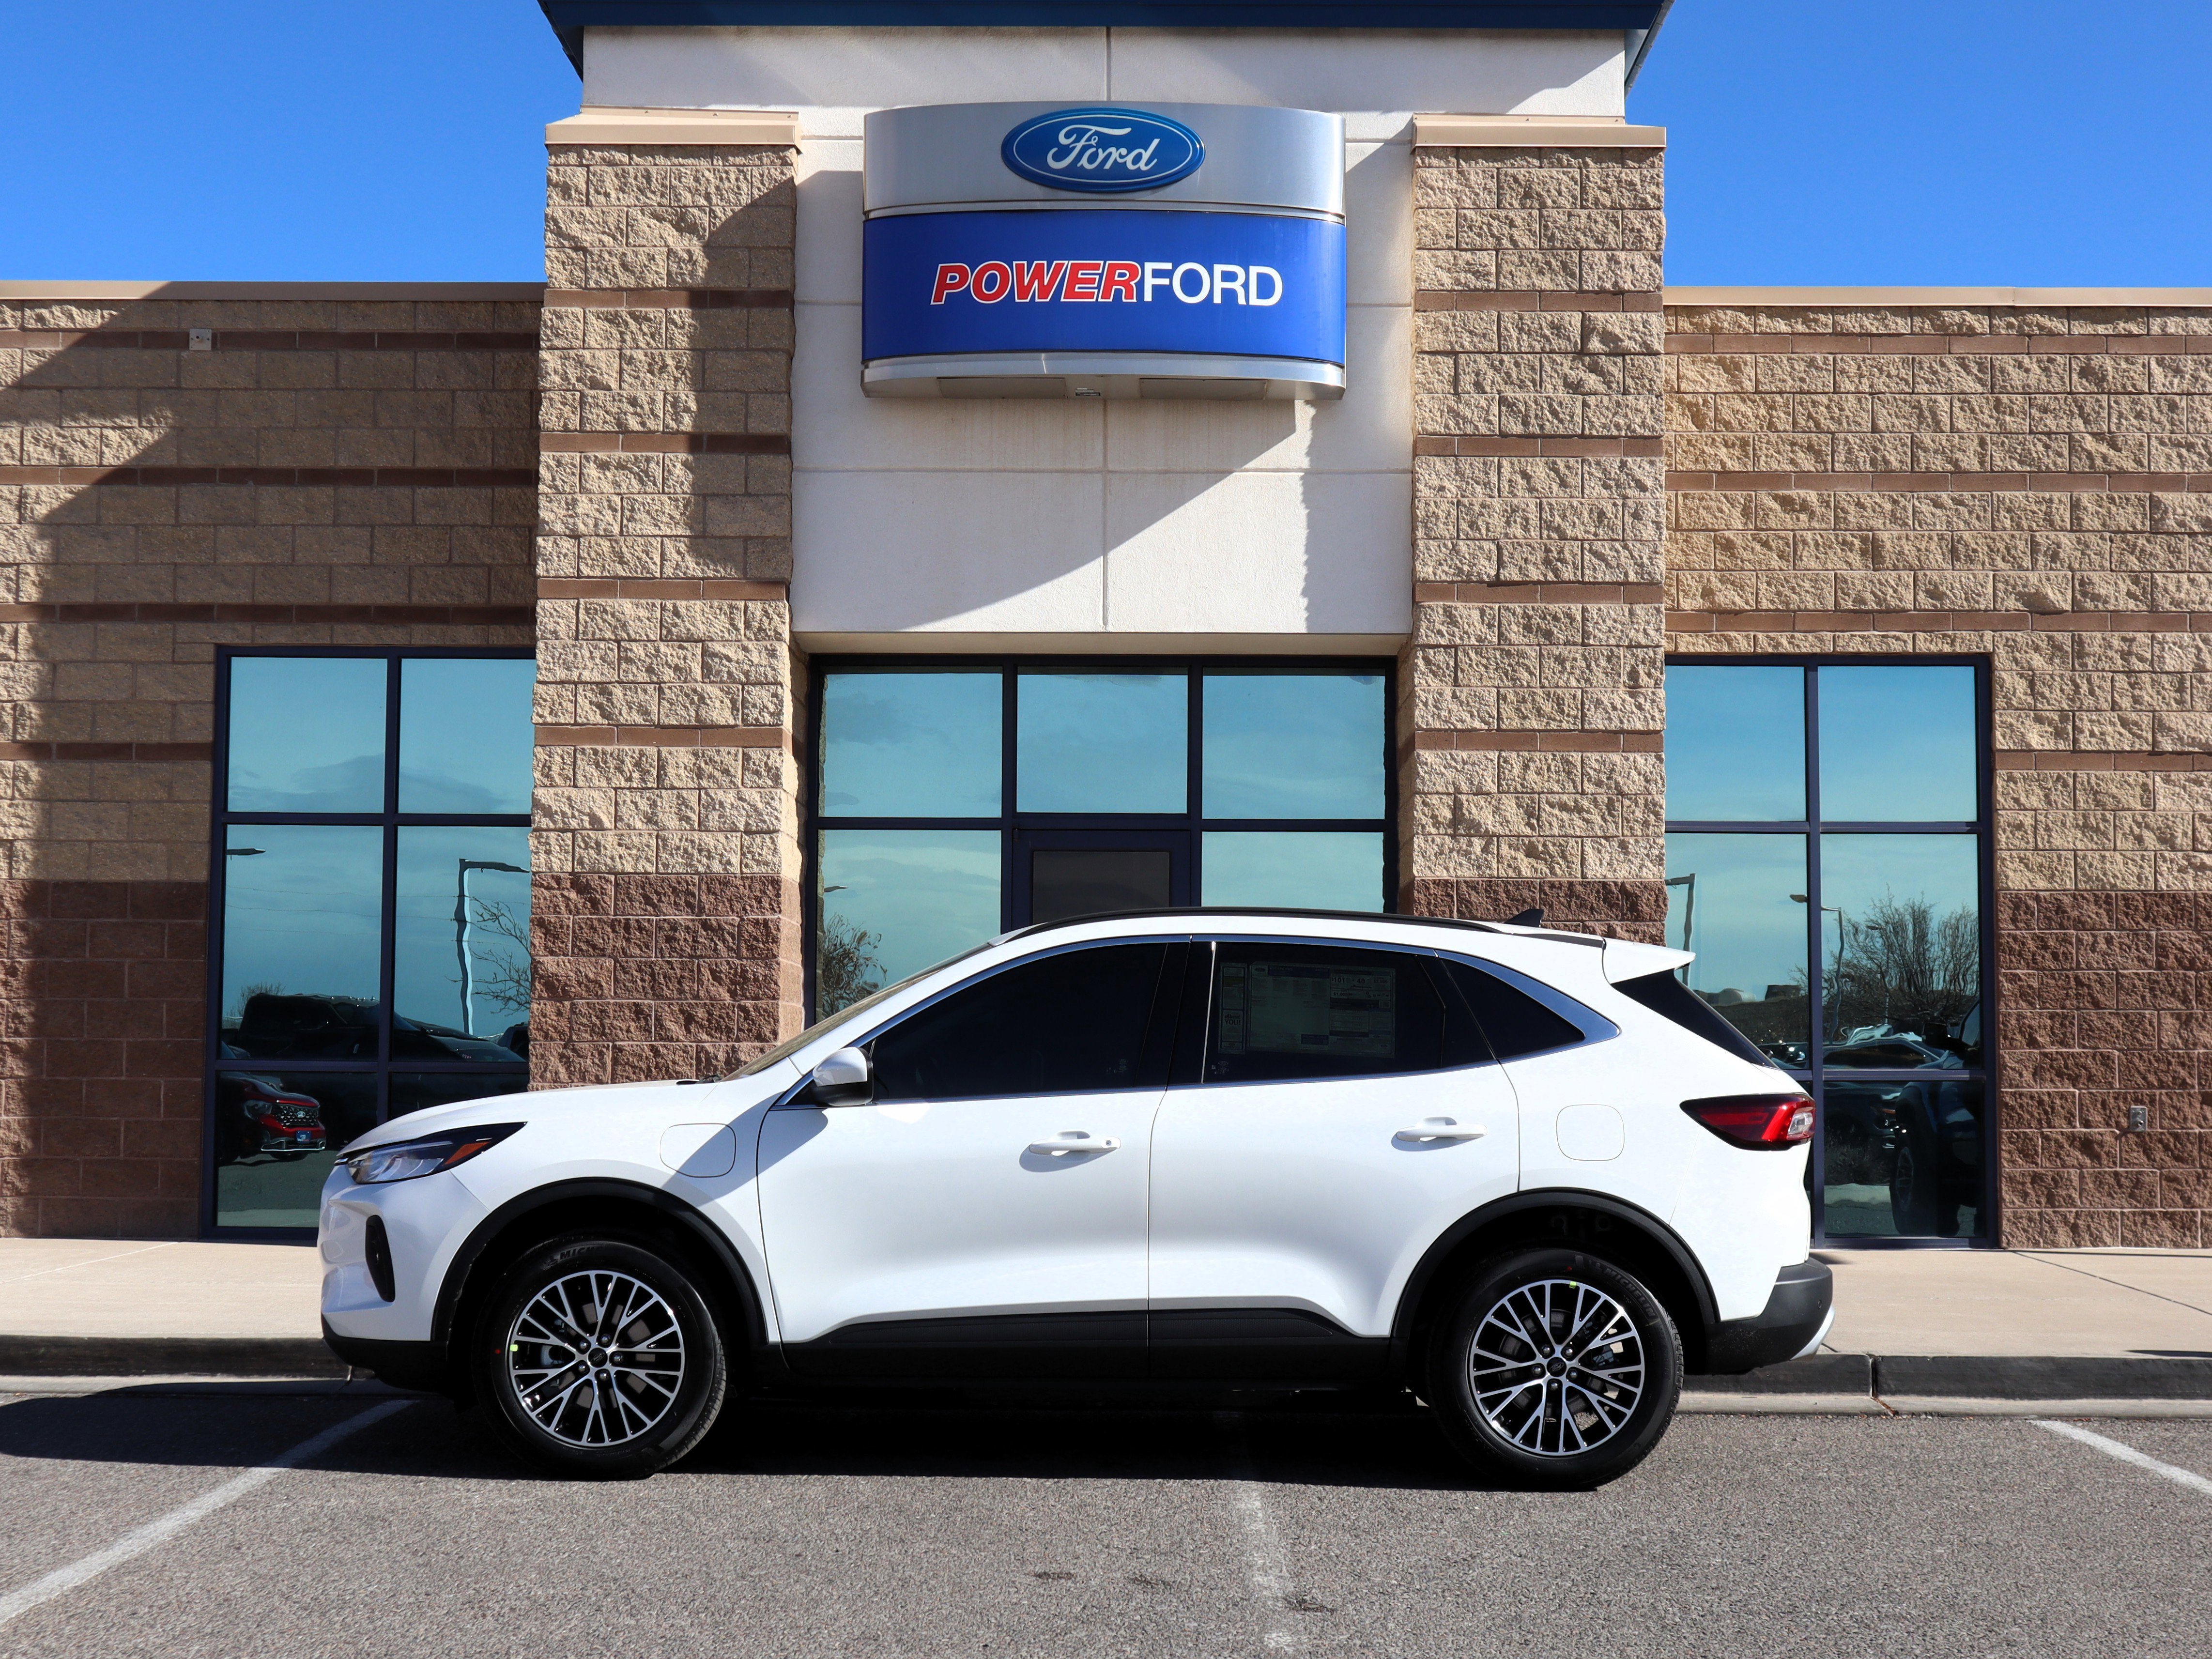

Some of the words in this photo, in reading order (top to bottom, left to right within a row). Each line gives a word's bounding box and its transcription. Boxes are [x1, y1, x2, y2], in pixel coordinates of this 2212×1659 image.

[1047, 124, 1160, 171] Ford
[930, 260, 1283, 306] POWERFORD
[1604, 1268, 1656, 1317] MICHELIN
